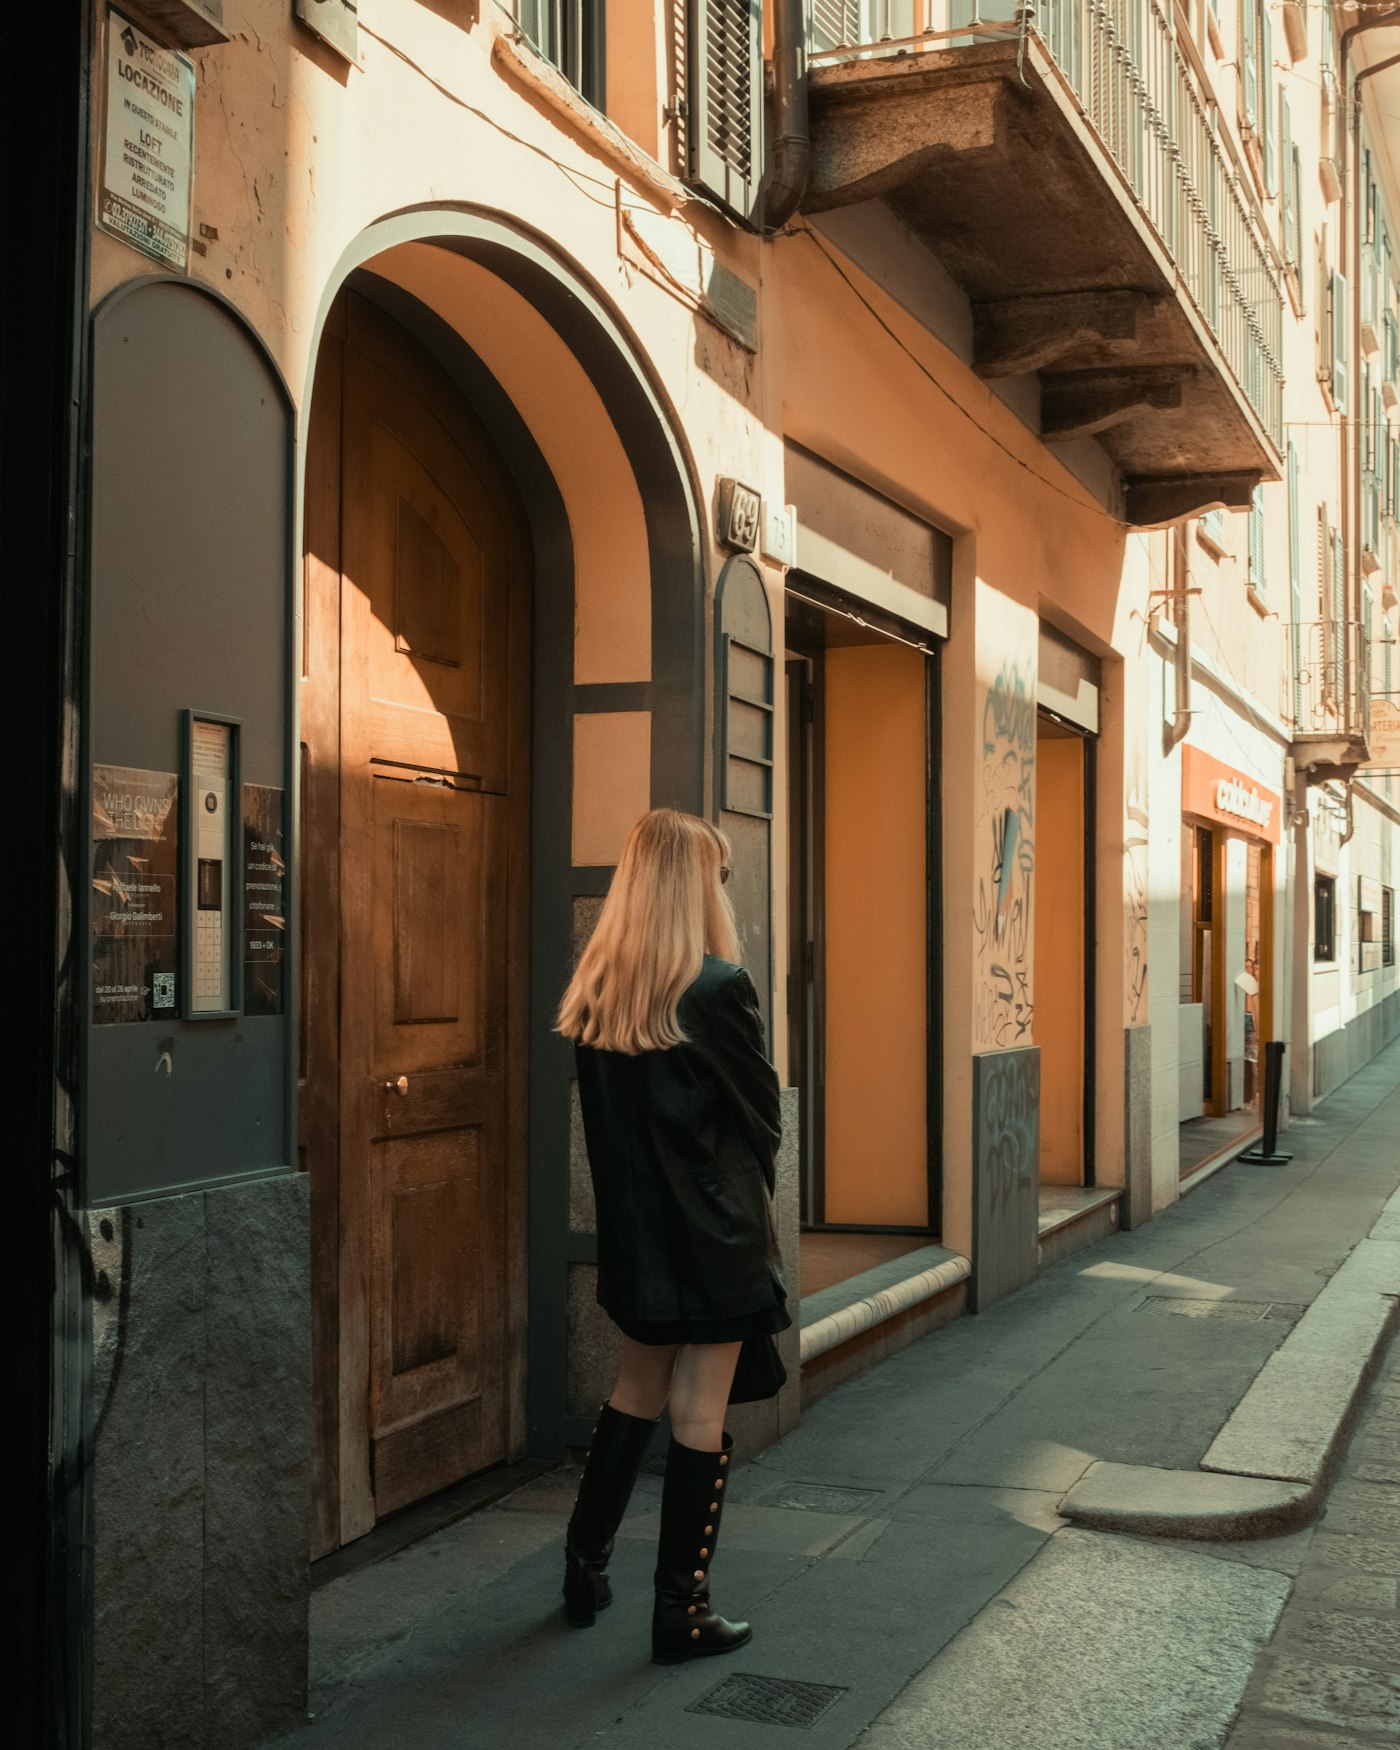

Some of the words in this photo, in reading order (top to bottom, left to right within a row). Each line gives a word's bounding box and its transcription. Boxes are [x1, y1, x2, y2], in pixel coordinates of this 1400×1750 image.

[118, 59, 183, 117] LOCAZIONE
[124, 98, 131, 109] IN
[131, 101, 155, 125] QUESTO
[155, 117, 178, 140] STABILE
[140, 129, 162, 153] LOFT
[124, 139, 175, 178] RECENTEMENTE
[124, 153, 174, 191] RISTRUTTURATO
[132, 173, 166, 200] ARREDATO
[132, 187, 166, 214] LUMINOSO
[108, 216, 151, 247] VALUTAZIONI
[151, 240, 181, 263] GRATUITE
[734, 491, 758, 540] 69
[103, 792, 131, 811] WHO
[135, 795, 170, 815] OWNS
[107, 811, 131, 830] THE
[250, 841, 258, 850] Se
[255, 862, 271, 871] codice
[110, 911, 131, 923] Giorgio
[132, 911, 163, 921] Galimberti
[250, 941, 262, 950] 1933
[266, 941, 274, 950] OK
[96, 985, 104, 994] dal
[104, 985, 111, 993] 20
[124, 985, 138, 994] aprile
[107, 995, 138, 1003] prenotazione
